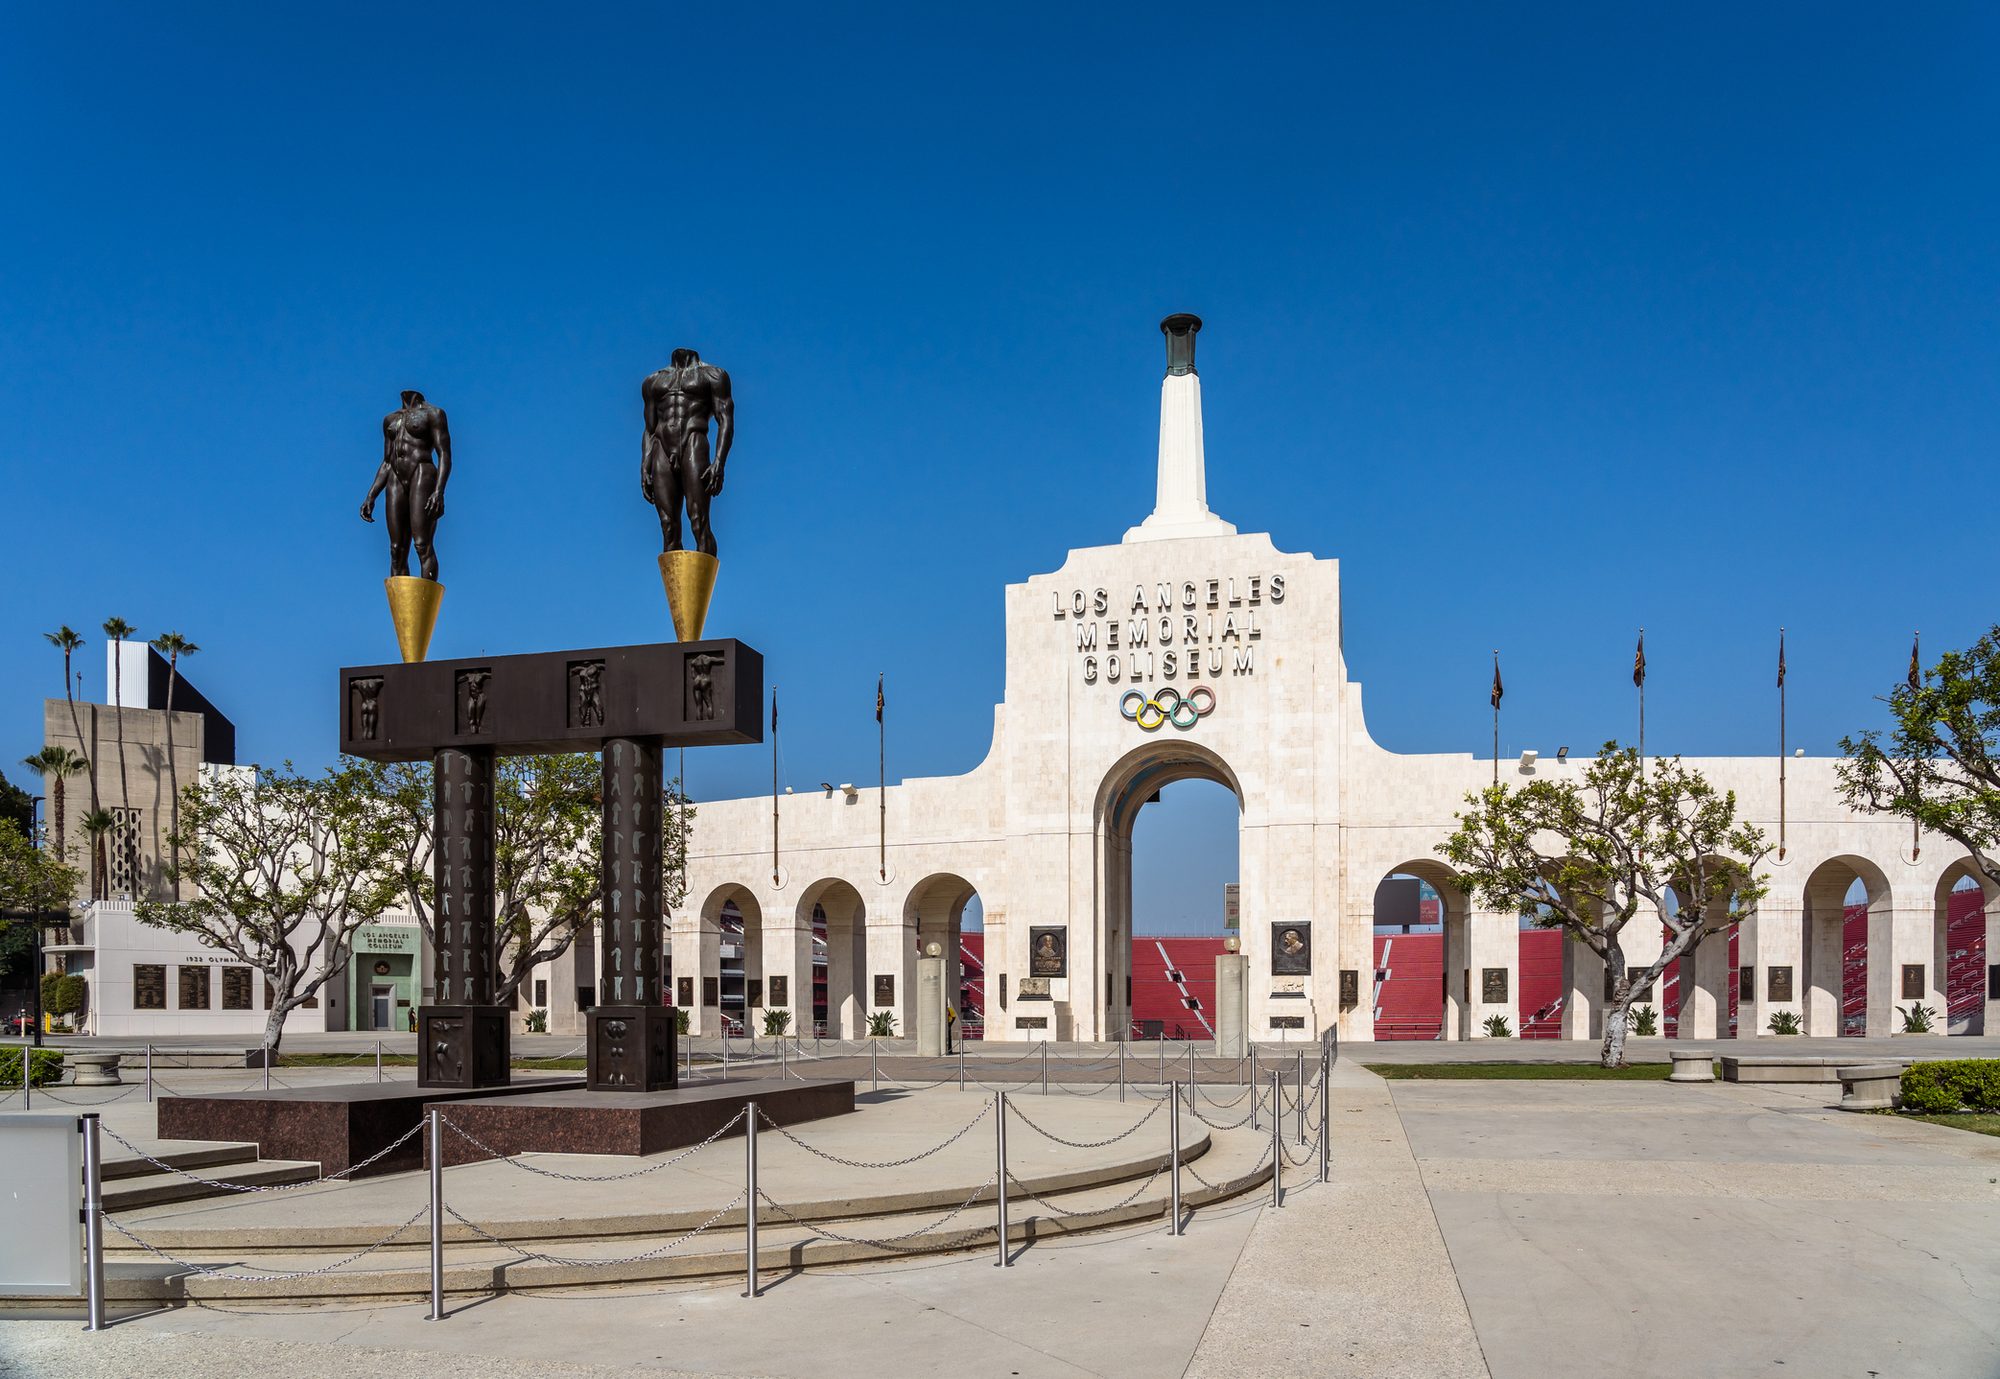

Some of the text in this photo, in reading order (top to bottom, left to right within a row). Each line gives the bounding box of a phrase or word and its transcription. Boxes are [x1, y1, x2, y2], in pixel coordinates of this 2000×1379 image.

[1053, 574, 1284, 617] LOS ANGELES
[1077, 610, 1261, 649] MEMORIAL
[1084, 645, 1253, 682] COLISEUM
